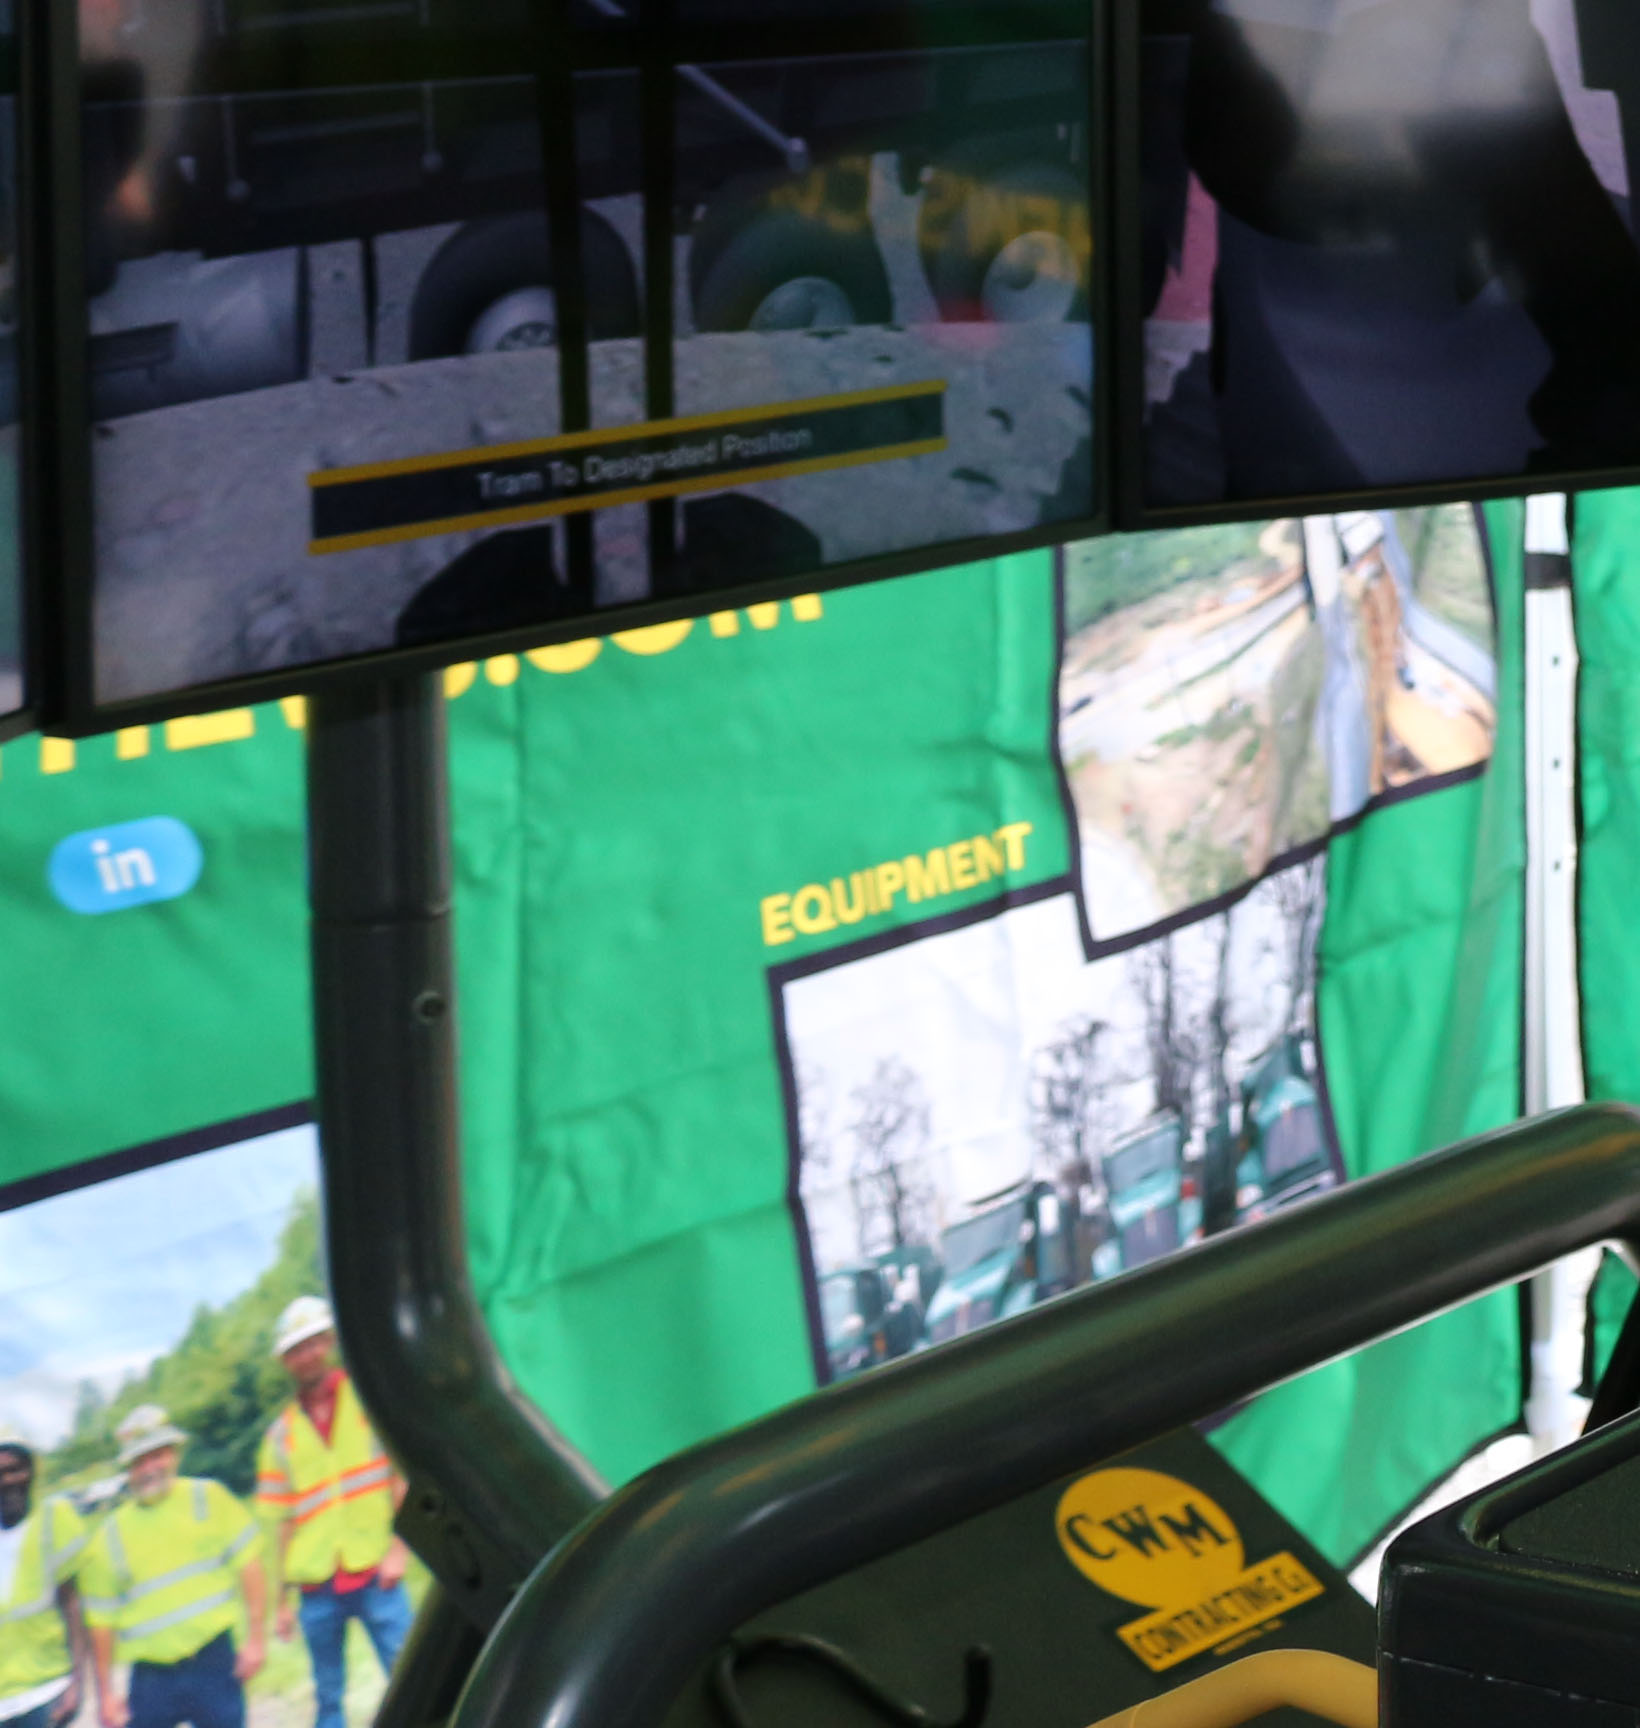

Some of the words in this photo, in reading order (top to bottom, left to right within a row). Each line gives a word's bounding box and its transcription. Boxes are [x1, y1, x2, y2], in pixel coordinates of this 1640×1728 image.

[476, 469, 543, 501] Tram
[547, 459, 579, 488] To
[583, 437, 718, 481] Designated
[720, 426, 814, 460] Position
[760, 820, 1034, 947] EQUIPMENT
[1064, 1503, 1232, 1561] CWM
[1133, 1574, 1285, 1661] CONTRACTING
